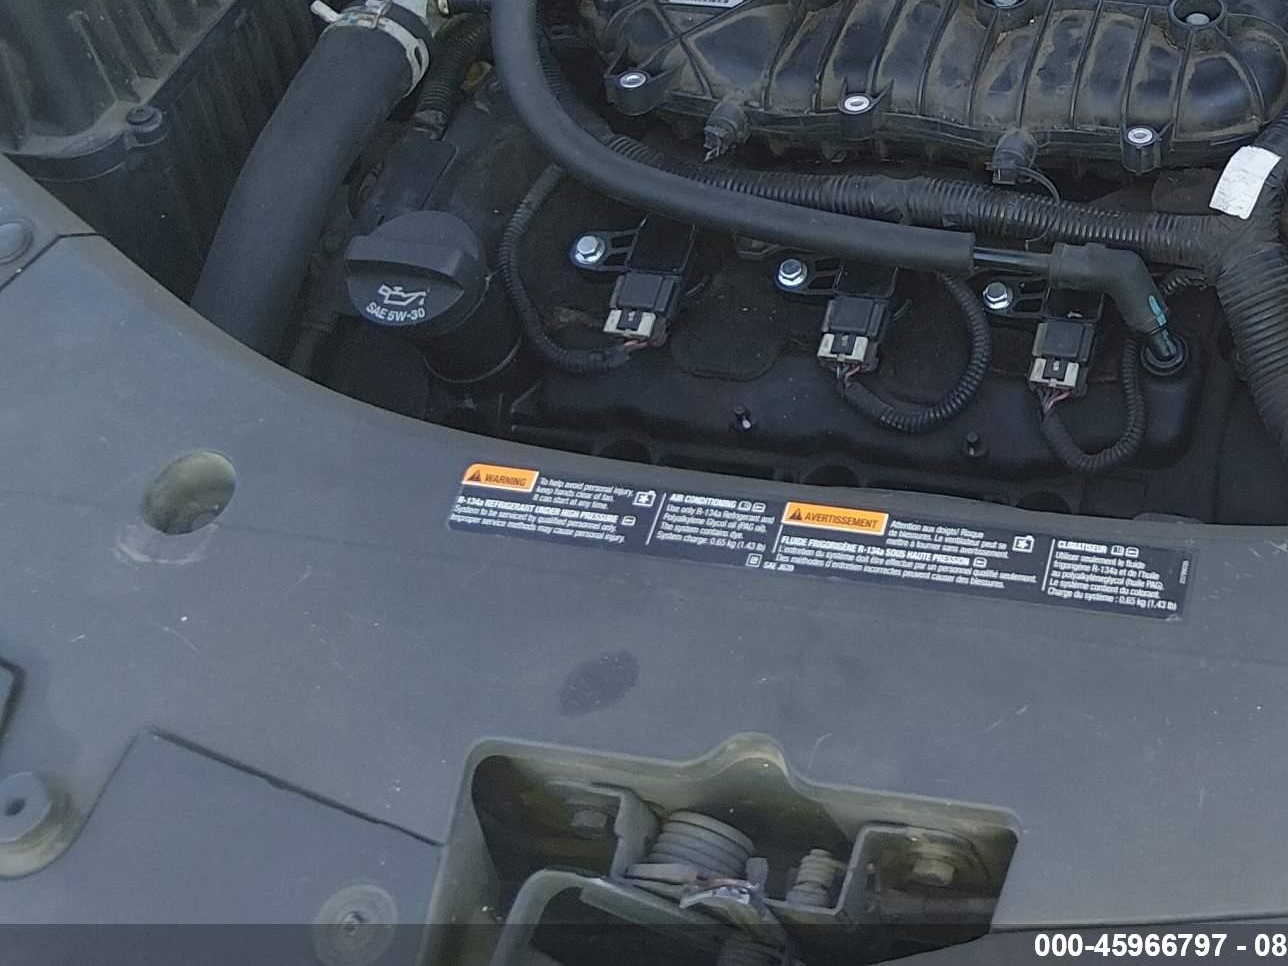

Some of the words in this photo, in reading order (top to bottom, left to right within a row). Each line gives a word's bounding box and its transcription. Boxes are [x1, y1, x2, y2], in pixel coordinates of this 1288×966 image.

[366, 302, 388, 319] SAE
[387, 308, 426, 322] 5W-30
[485, 474, 526, 486] WARNING
[670, 494, 684, 502] AIR
[685, 496, 736, 508] CONDITIONING
[805, 513, 877, 528] AVERTISSEMENT
